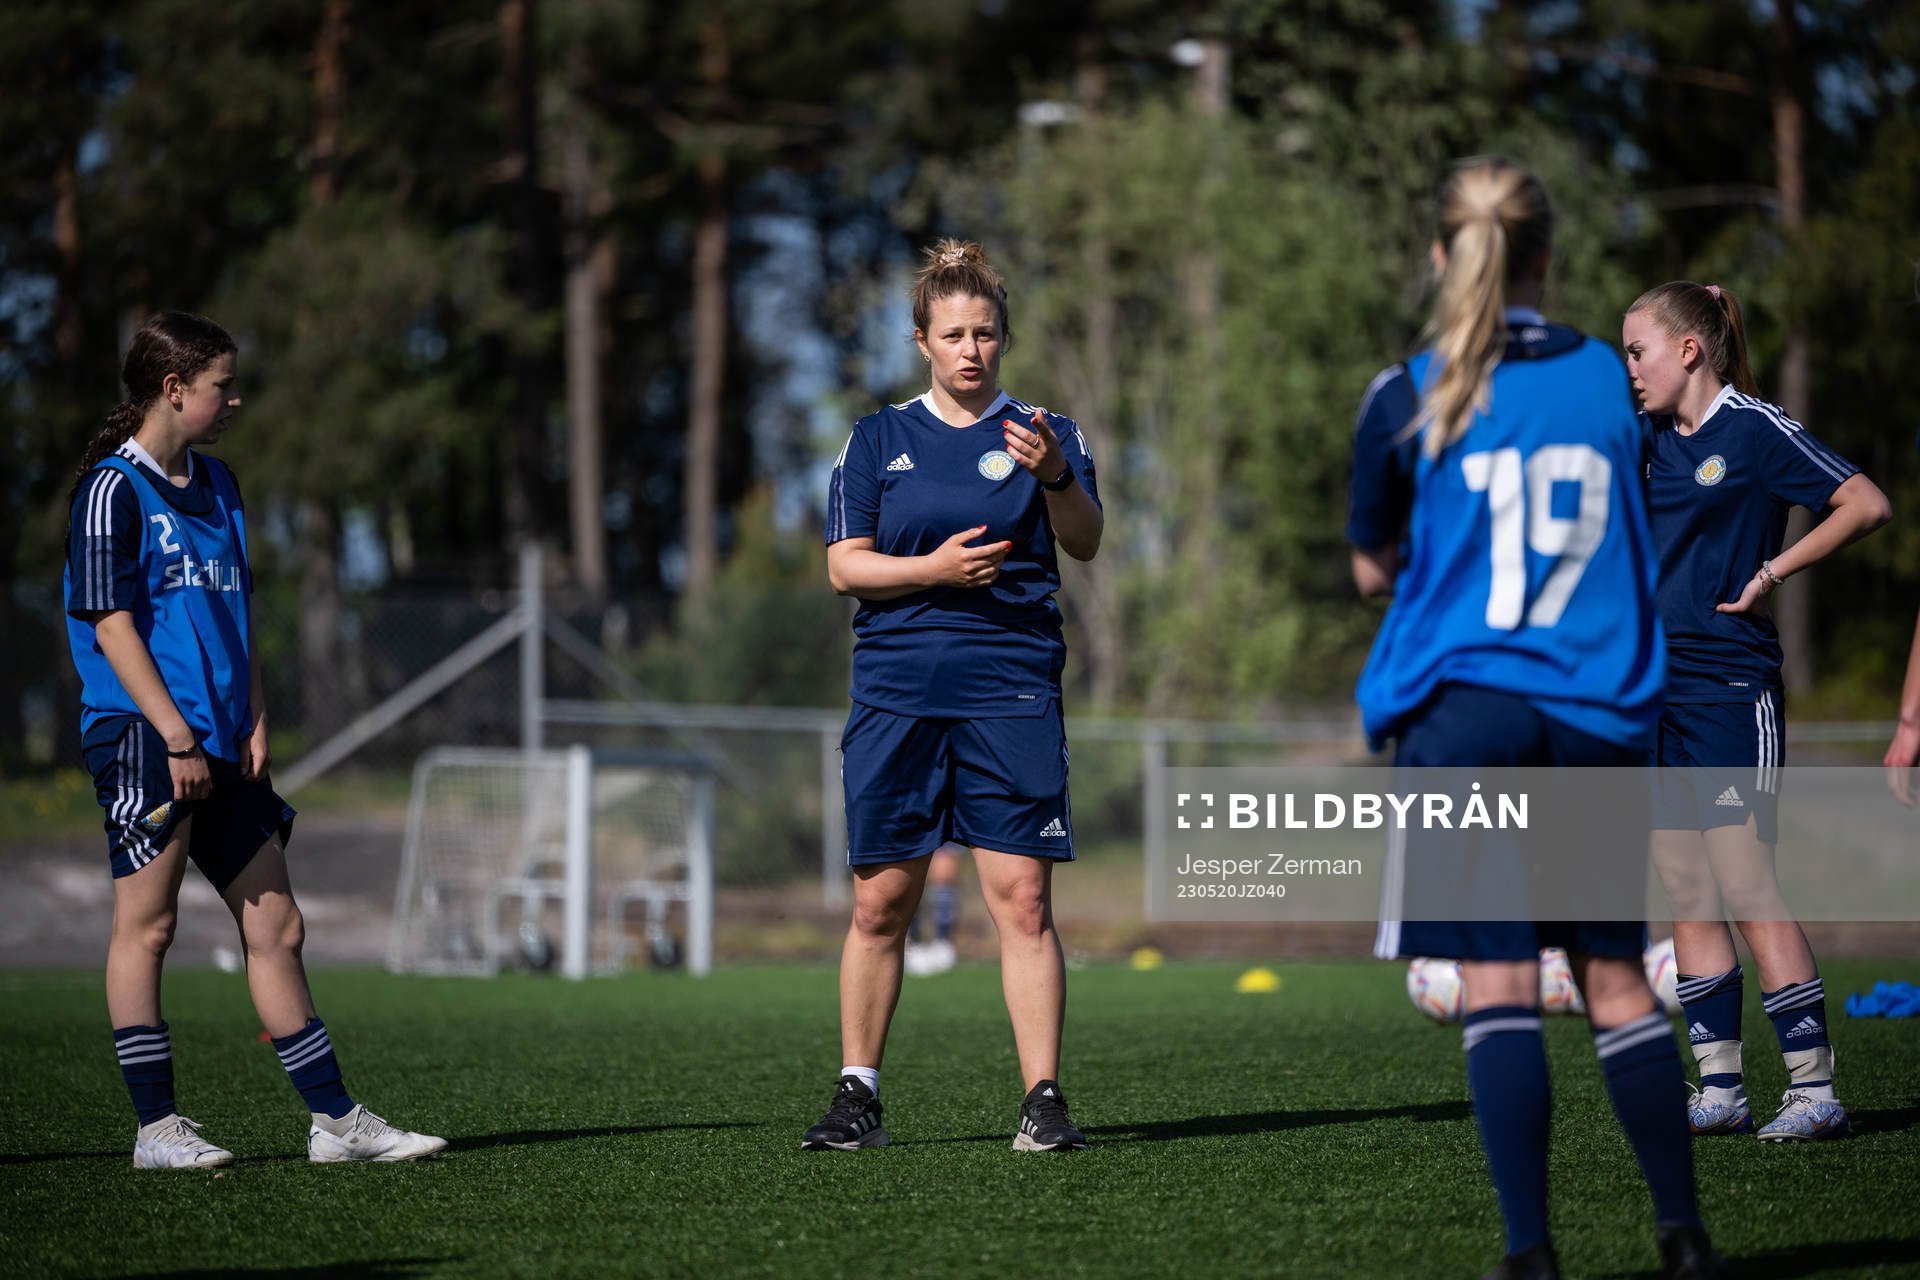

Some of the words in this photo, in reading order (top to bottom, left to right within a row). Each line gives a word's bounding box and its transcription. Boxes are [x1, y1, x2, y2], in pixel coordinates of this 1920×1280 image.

[886, 463, 915, 471] adidas
[150, 512, 180, 554] 2
[1461, 443, 1612, 630] 19
[1715, 798, 1744, 807] adidas
[1040, 829, 1067, 837] adidas
[1786, 1026, 1823, 1039] adidas
